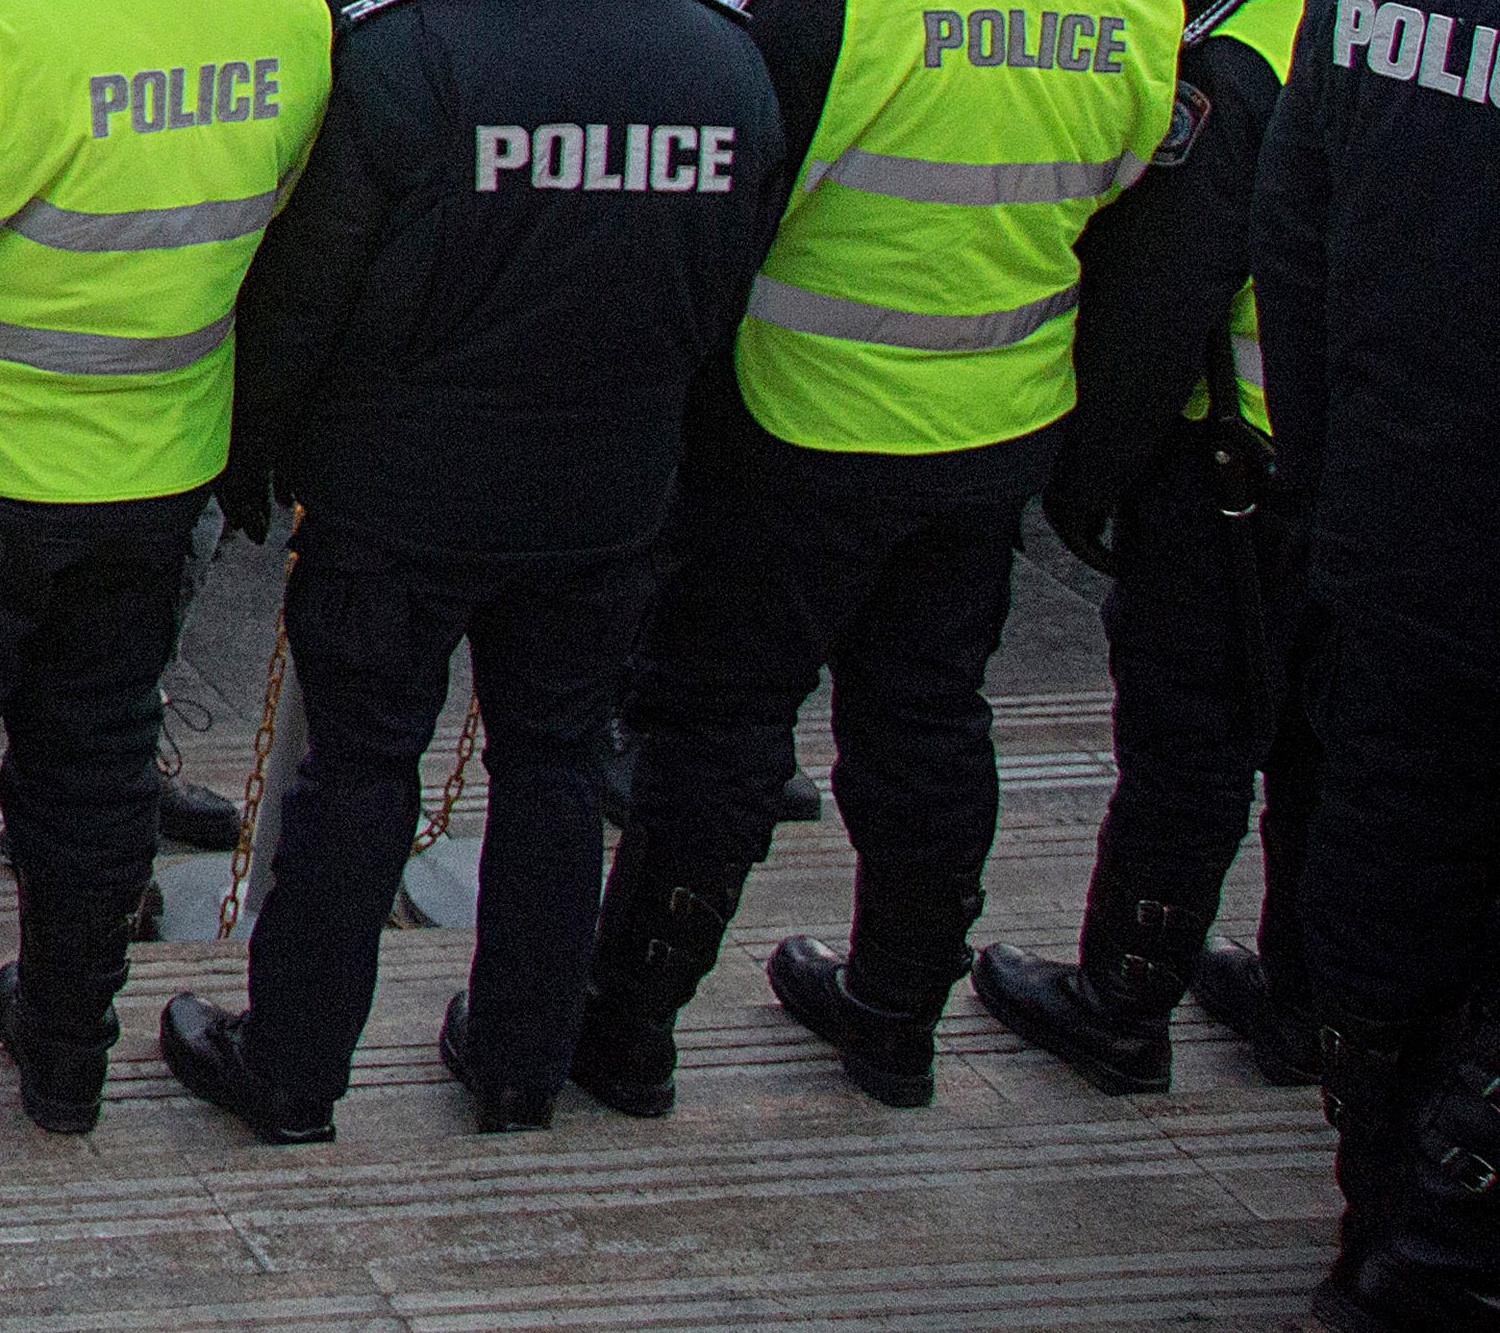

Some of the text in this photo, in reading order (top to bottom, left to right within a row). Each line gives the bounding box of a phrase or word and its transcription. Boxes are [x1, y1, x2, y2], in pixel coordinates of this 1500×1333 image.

[924, 9, 1126, 73] POLICE
[90, 58, 279, 138] POLICE
[476, 124, 735, 193] POLICE
